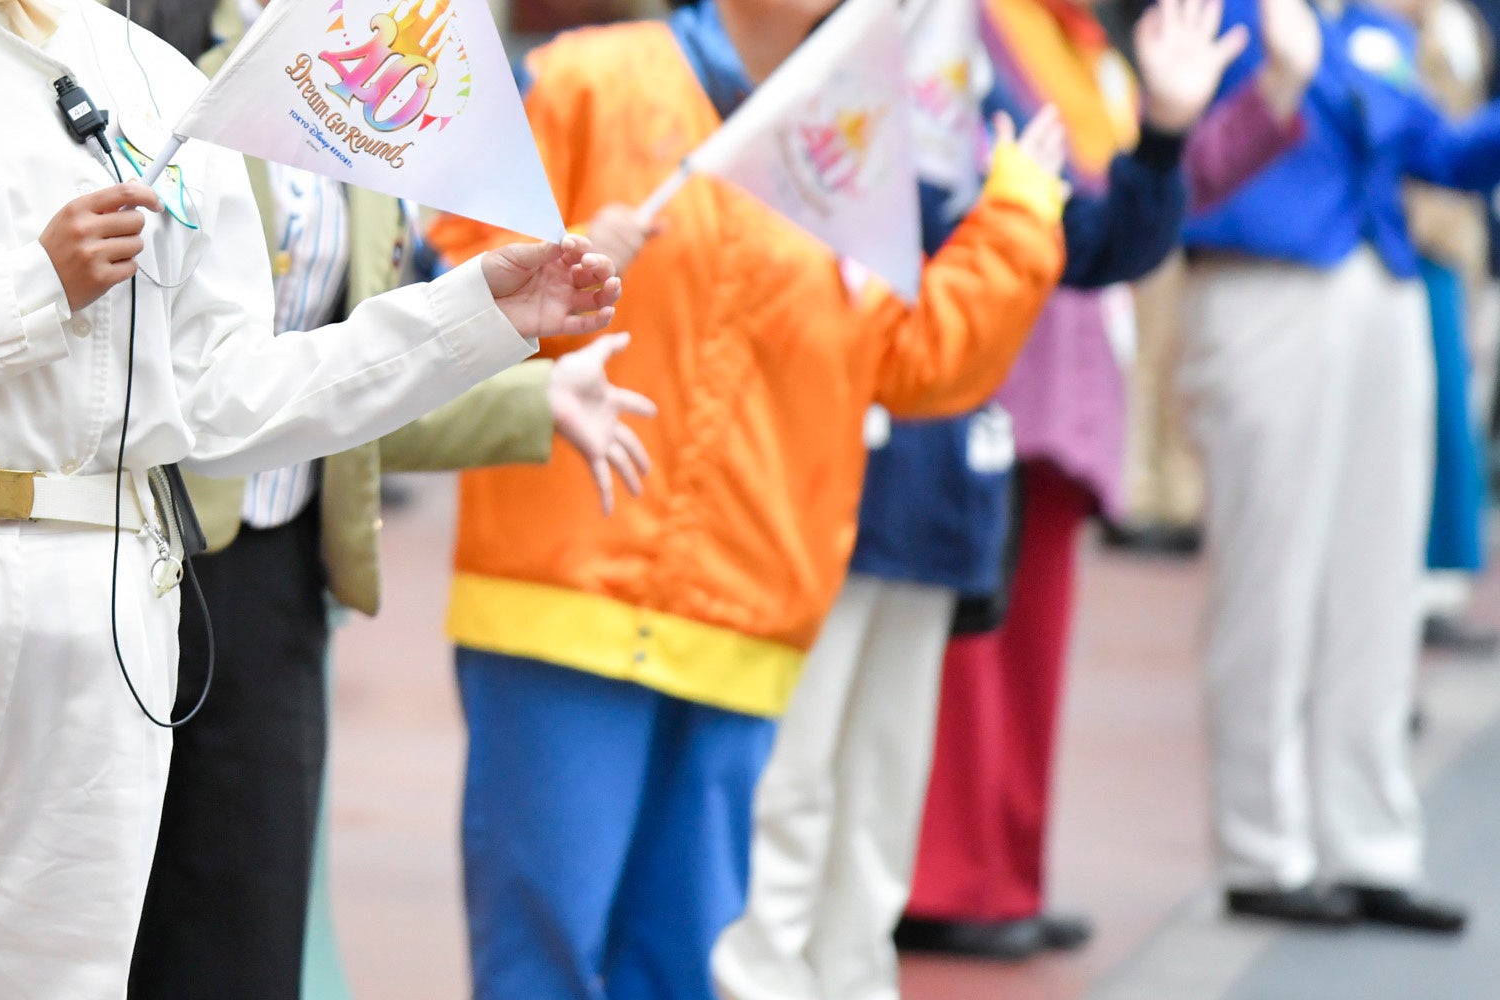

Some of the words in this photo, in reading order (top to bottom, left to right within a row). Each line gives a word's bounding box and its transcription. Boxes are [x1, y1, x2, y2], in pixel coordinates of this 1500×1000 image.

[318, 13, 438, 132] 40
[74, 104, 87, 116] 42
[289, 109, 310, 129] TOKYO
